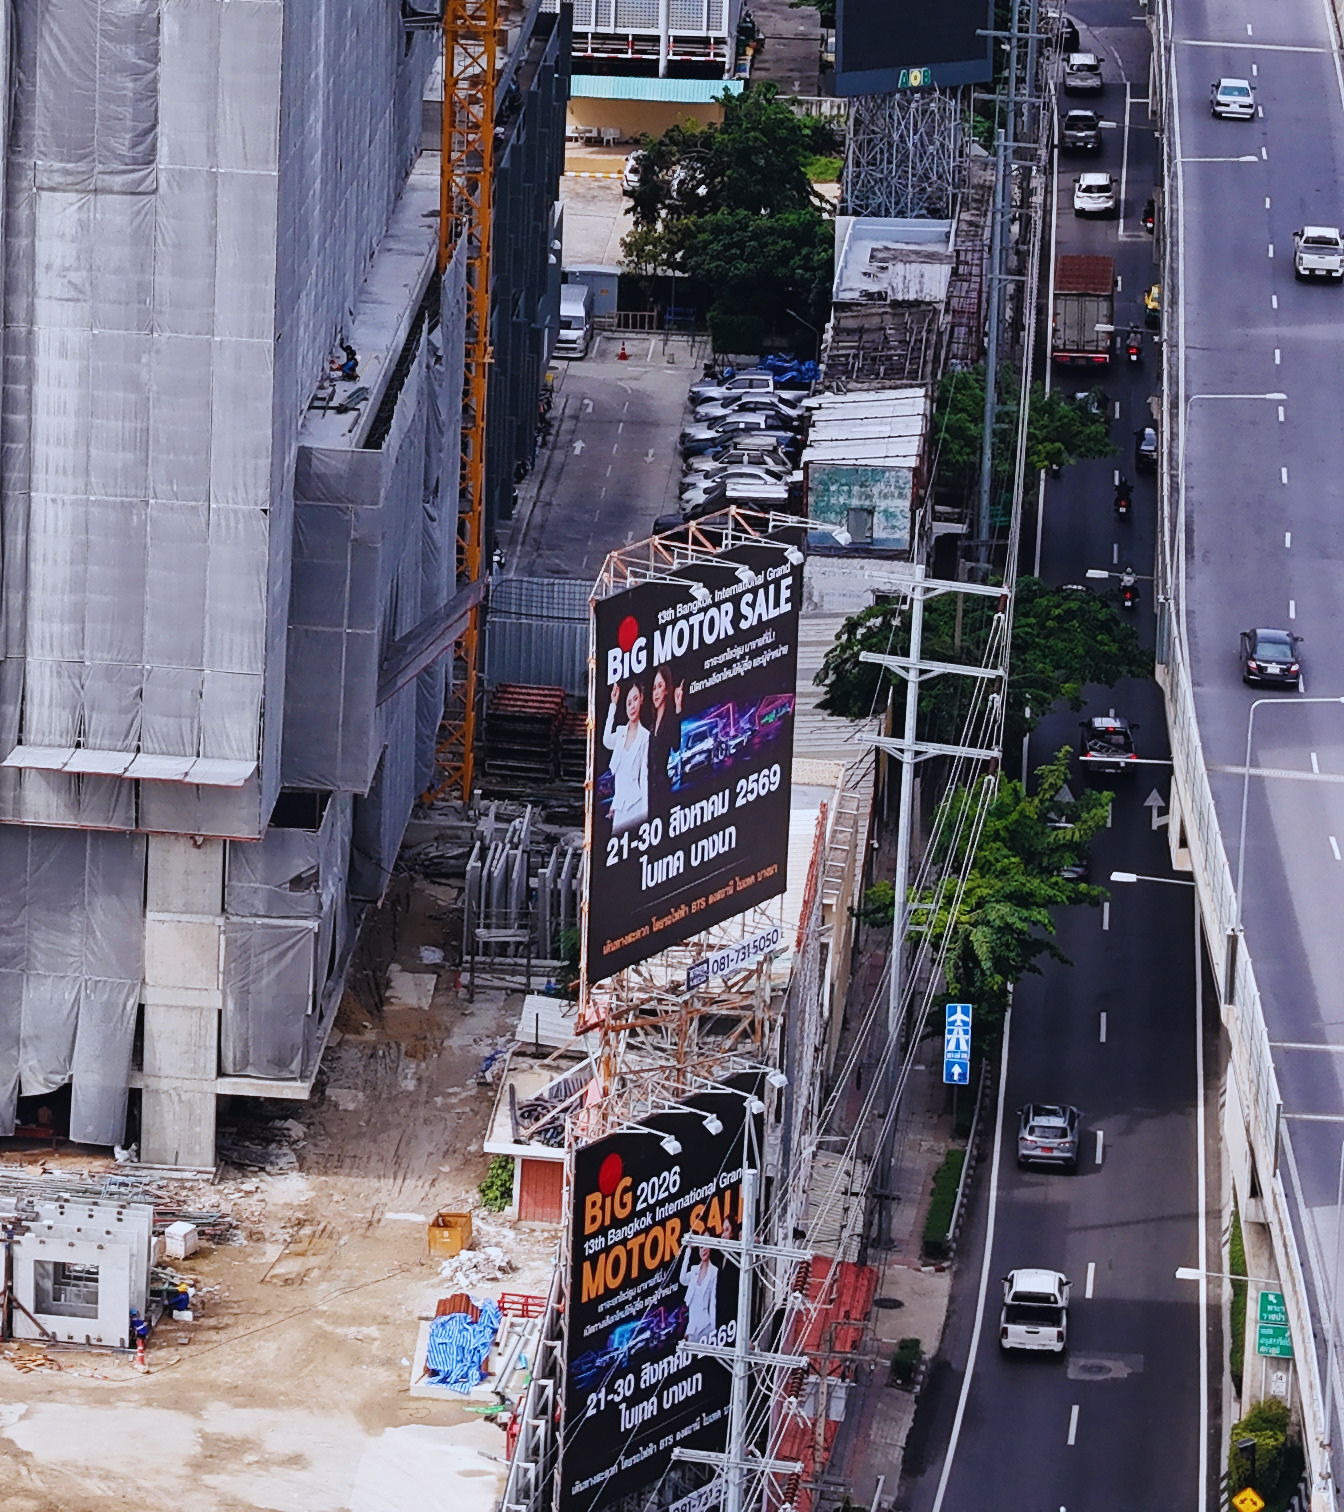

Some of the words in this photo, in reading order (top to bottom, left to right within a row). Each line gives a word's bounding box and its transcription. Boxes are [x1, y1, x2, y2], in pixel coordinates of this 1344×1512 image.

[898, 68, 932, 88] AOB
[653, 601, 735, 667] MOTOR
[739, 576, 793, 630] SALE
[658, 607, 675, 625] 13th
[766, 562, 791, 582] Grand
[606, 817, 663, 867] 21-30
[669, 789, 730, 838] สิงหาคม
[735, 763, 781, 807] 2569
[639, 850, 684, 890] ไบเทค
[691, 825, 736, 867] บางนา
[691, 896, 706, 914] BTS
[583, 1237, 606, 1256] 13th
[607, 1212, 653, 1245] Bangkok
[655, 1179, 717, 1222] International
[718, 1167, 742, 1188] Gran
[635, 1165, 681, 1211] 2026
[581, 1217, 682, 1304] MOTOR
[586, 1373, 635, 1418] 21-30
[618, 1396, 658, 1432] ไบเทค
[663, 1373, 703, 1410] บางนา
